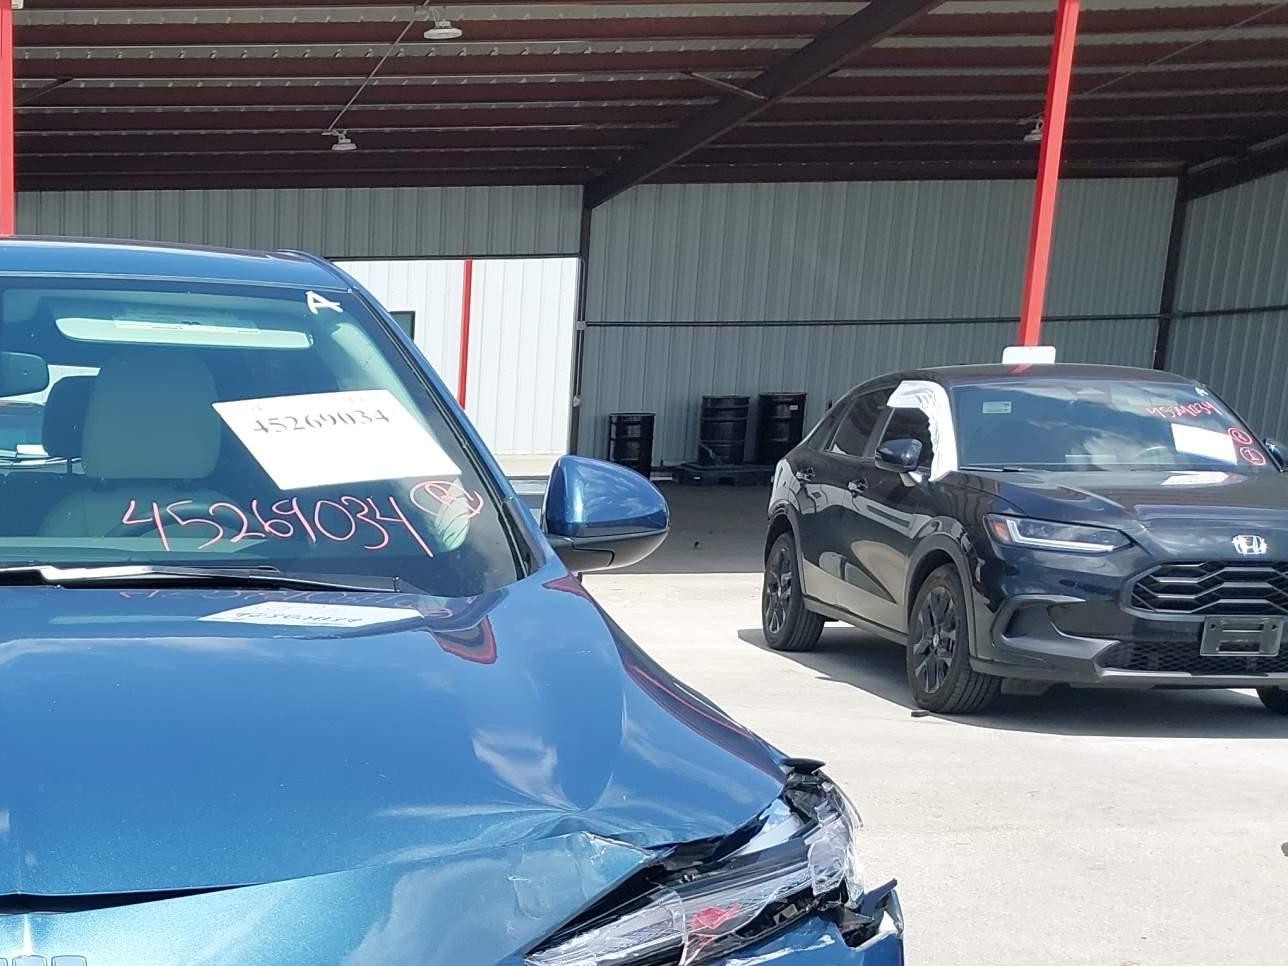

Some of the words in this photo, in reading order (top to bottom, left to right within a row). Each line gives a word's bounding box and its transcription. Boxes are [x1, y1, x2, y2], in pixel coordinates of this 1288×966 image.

[305, 290, 344, 315] A
[252, 409, 390, 433] 45269034
[122, 496, 434, 558] 45269034
